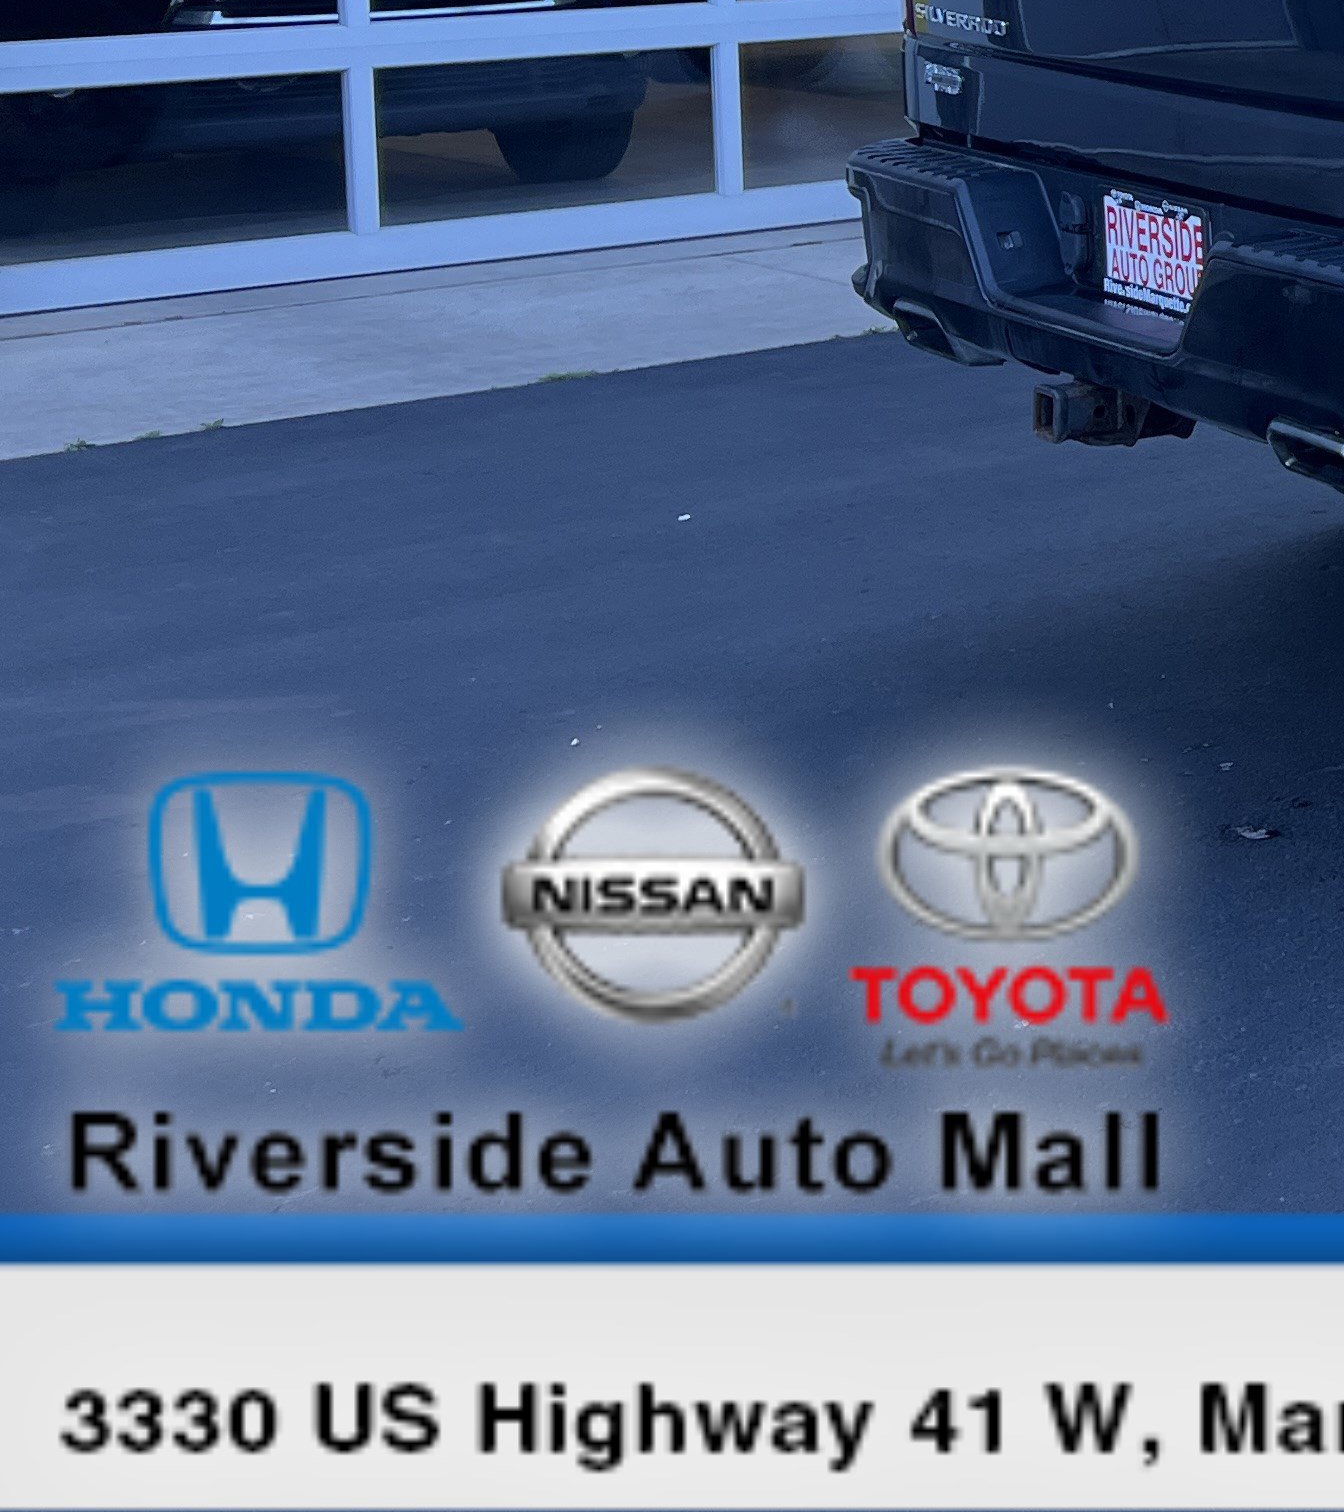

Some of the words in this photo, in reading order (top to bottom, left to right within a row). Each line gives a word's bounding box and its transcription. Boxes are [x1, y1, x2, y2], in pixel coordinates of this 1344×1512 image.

[914, 1, 1009, 38] SILVERADO
[1105, 204, 1205, 265] RIVERSIDE
[1111, 246, 1150, 287] AUTO
